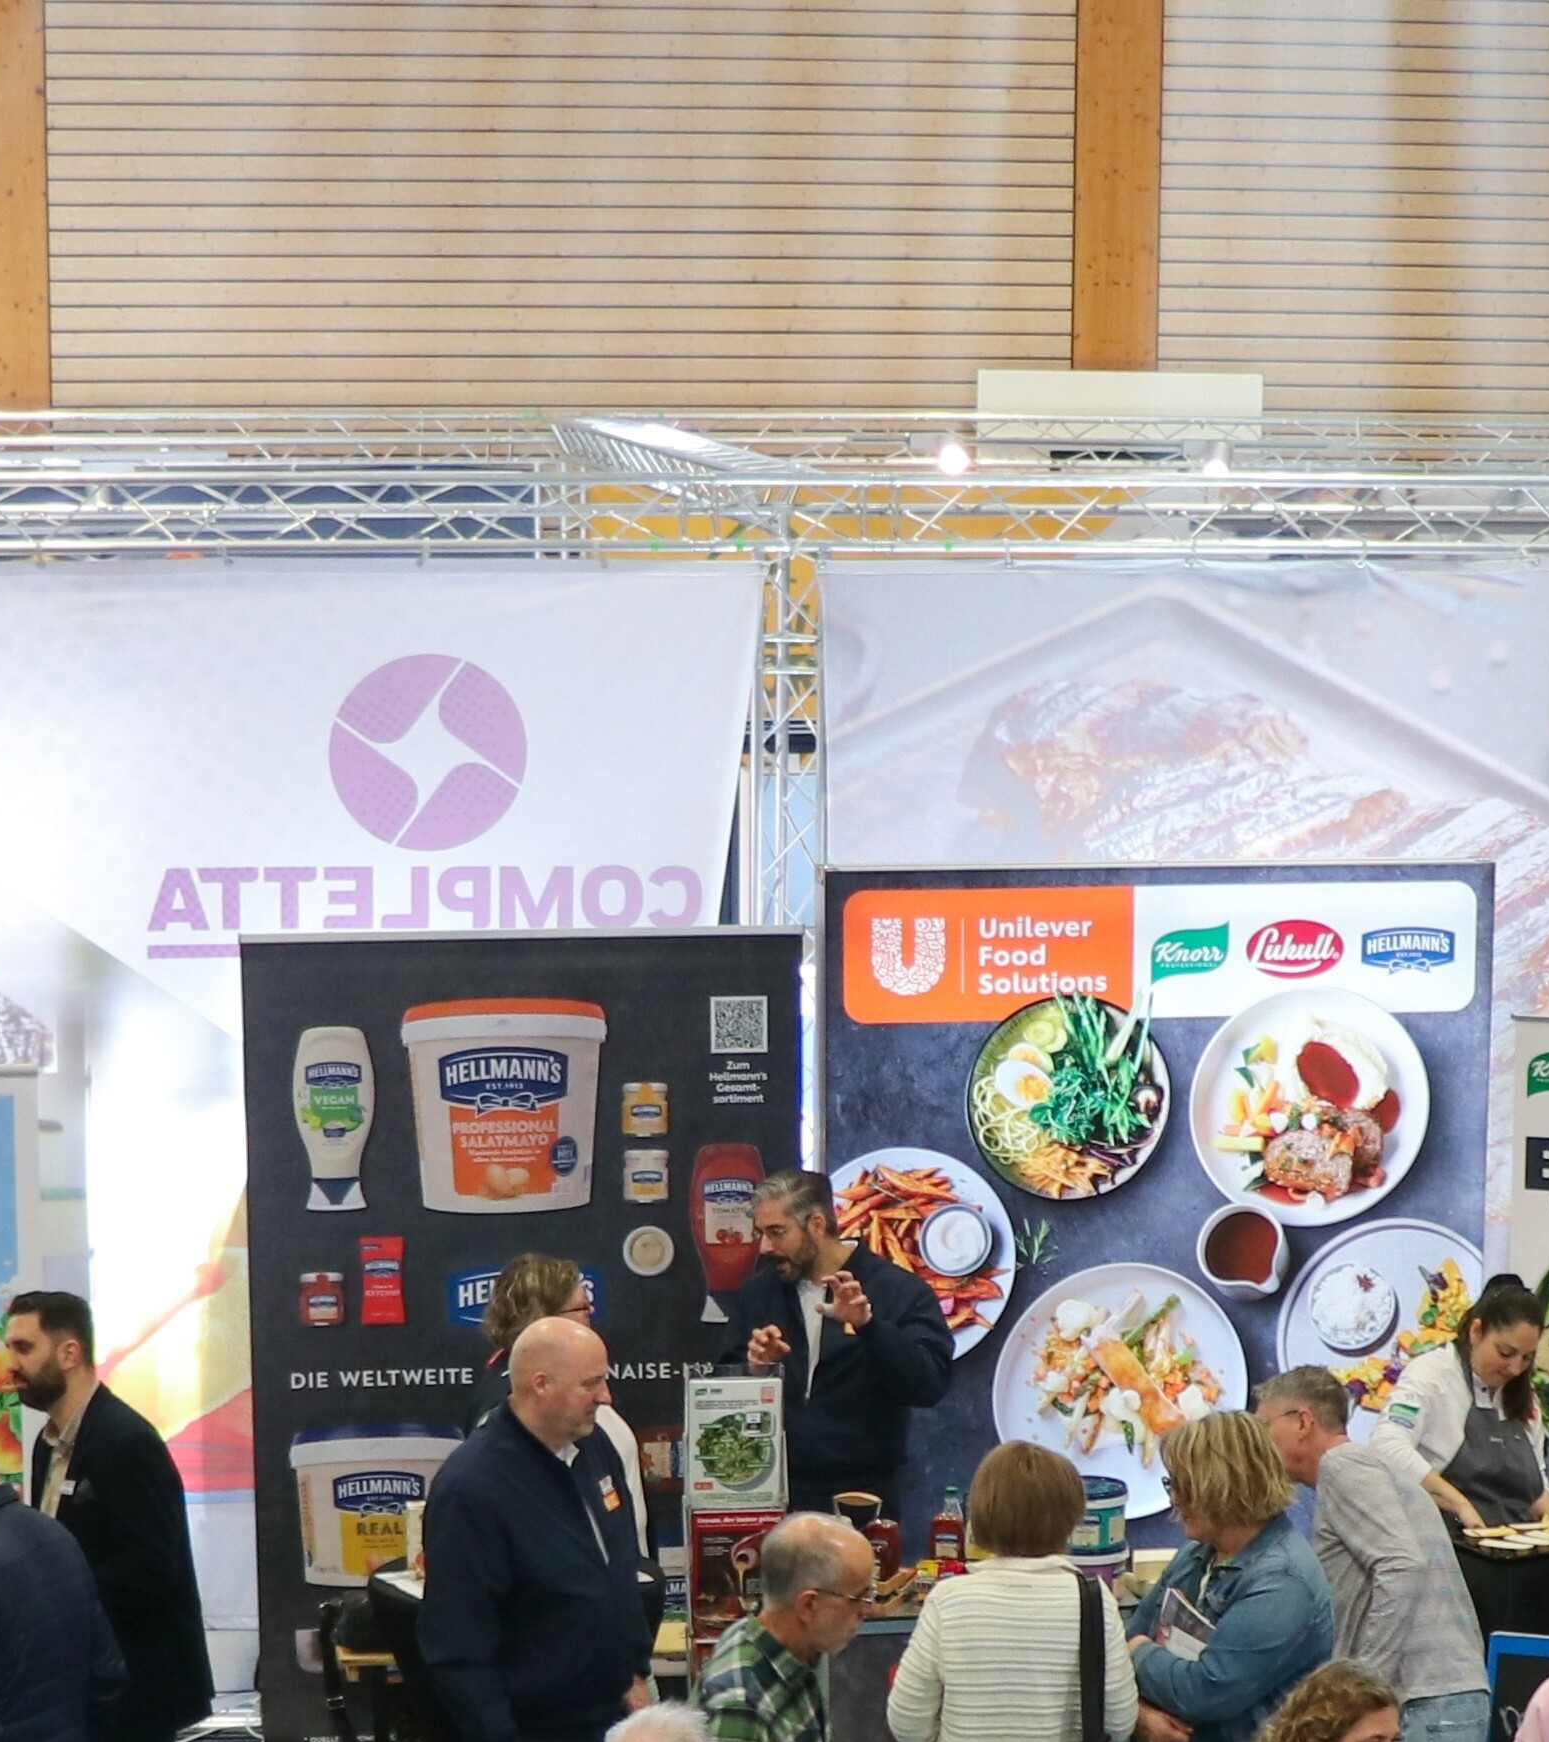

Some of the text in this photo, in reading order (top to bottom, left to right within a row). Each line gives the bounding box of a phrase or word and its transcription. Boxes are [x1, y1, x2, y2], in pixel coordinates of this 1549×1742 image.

[978, 917, 1093, 939] Unilever
[1154, 941, 1225, 963] Knorr
[1250, 927, 1335, 965] Lukull
[1366, 932, 1450, 955] HELLMANN'S
[978, 943, 1047, 967] Food
[978, 971, 1108, 995] Solutions
[445, 1056, 562, 1087] HELLMANN'S
[708, 1072, 768, 1082] Hellmann's
[726, 1061, 750, 1071] Zum
[712, 1094, 765, 1104] sortiment
[715, 1083, 761, 1093] Gesamt-
[313, 1095, 355, 1106] VEGAN
[452, 1119, 556, 1135] PROFESSIONAL
[460, 1134, 550, 1148] SALATMAYO
[290, 1371, 330, 1390] DIE
[339, 1367, 474, 1388] WELTWEITE
[337, 1477, 421, 1499] HELLMANN'S
[356, 1521, 405, 1537] REAL
